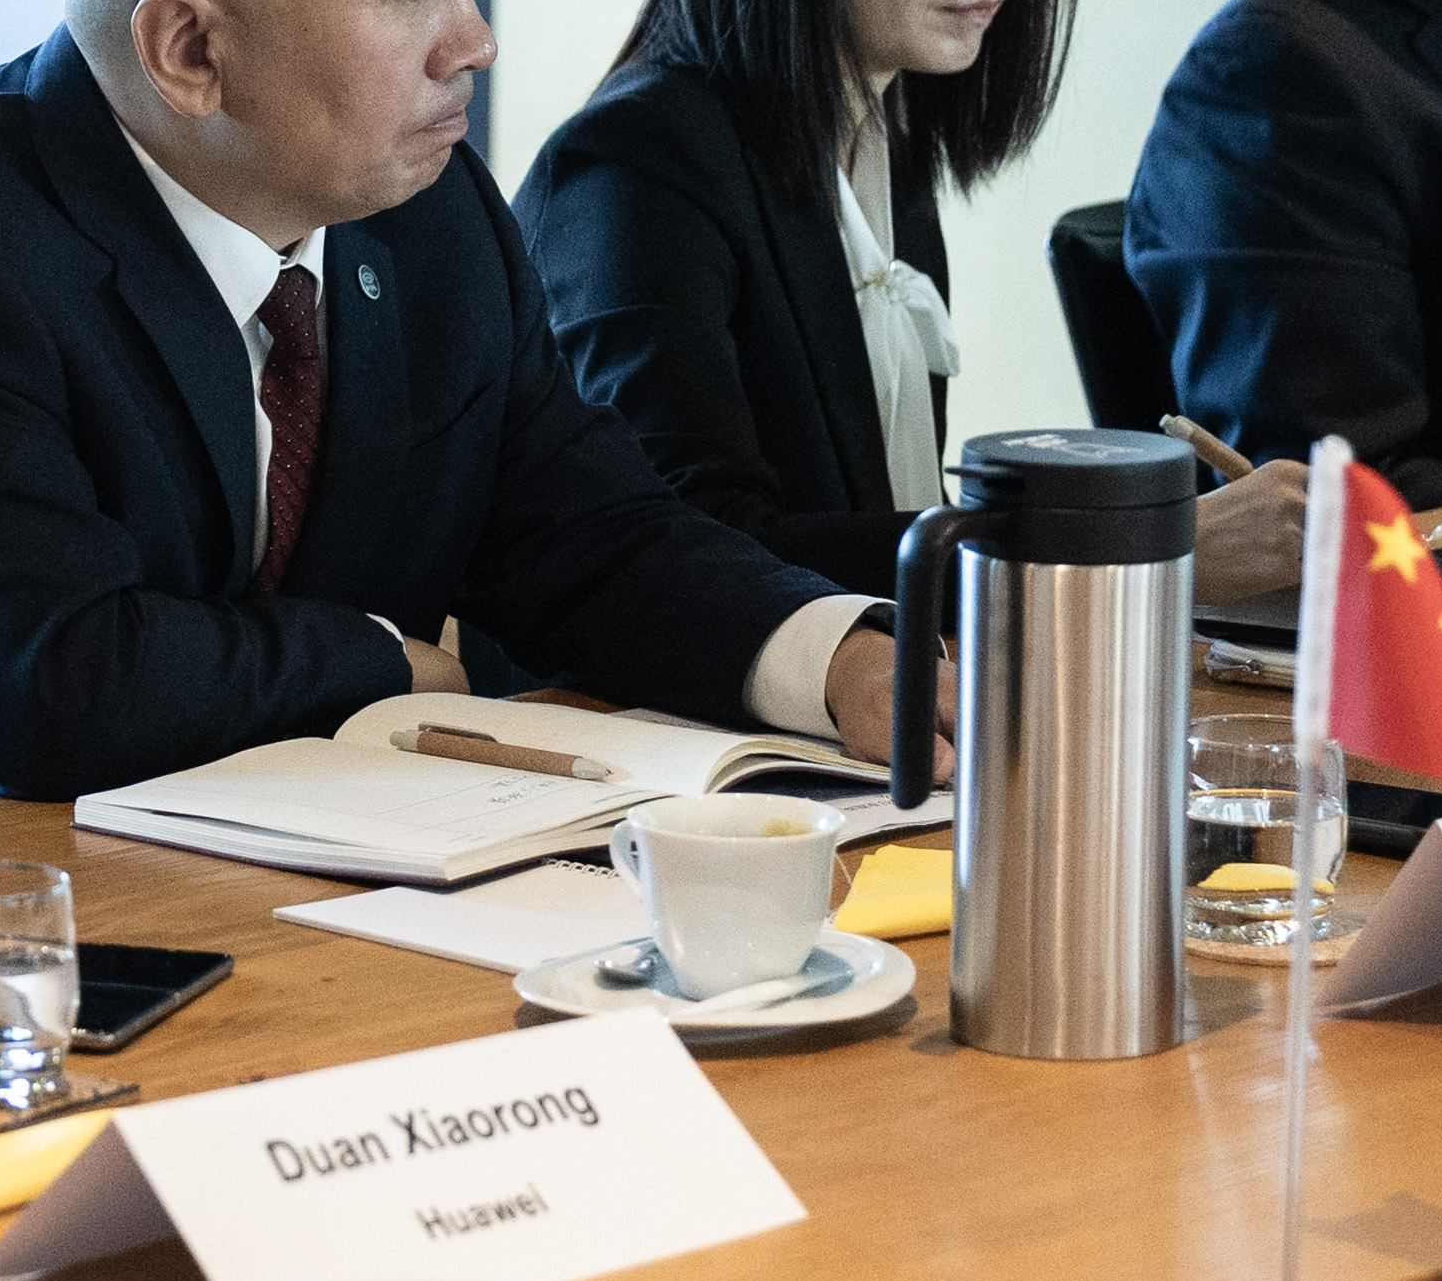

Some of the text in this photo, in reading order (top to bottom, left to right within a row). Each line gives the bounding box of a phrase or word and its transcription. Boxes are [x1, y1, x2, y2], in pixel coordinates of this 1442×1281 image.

[265, 1086, 600, 1182] Duan Xiaorong
[415, 1182, 551, 1239] Huawei
